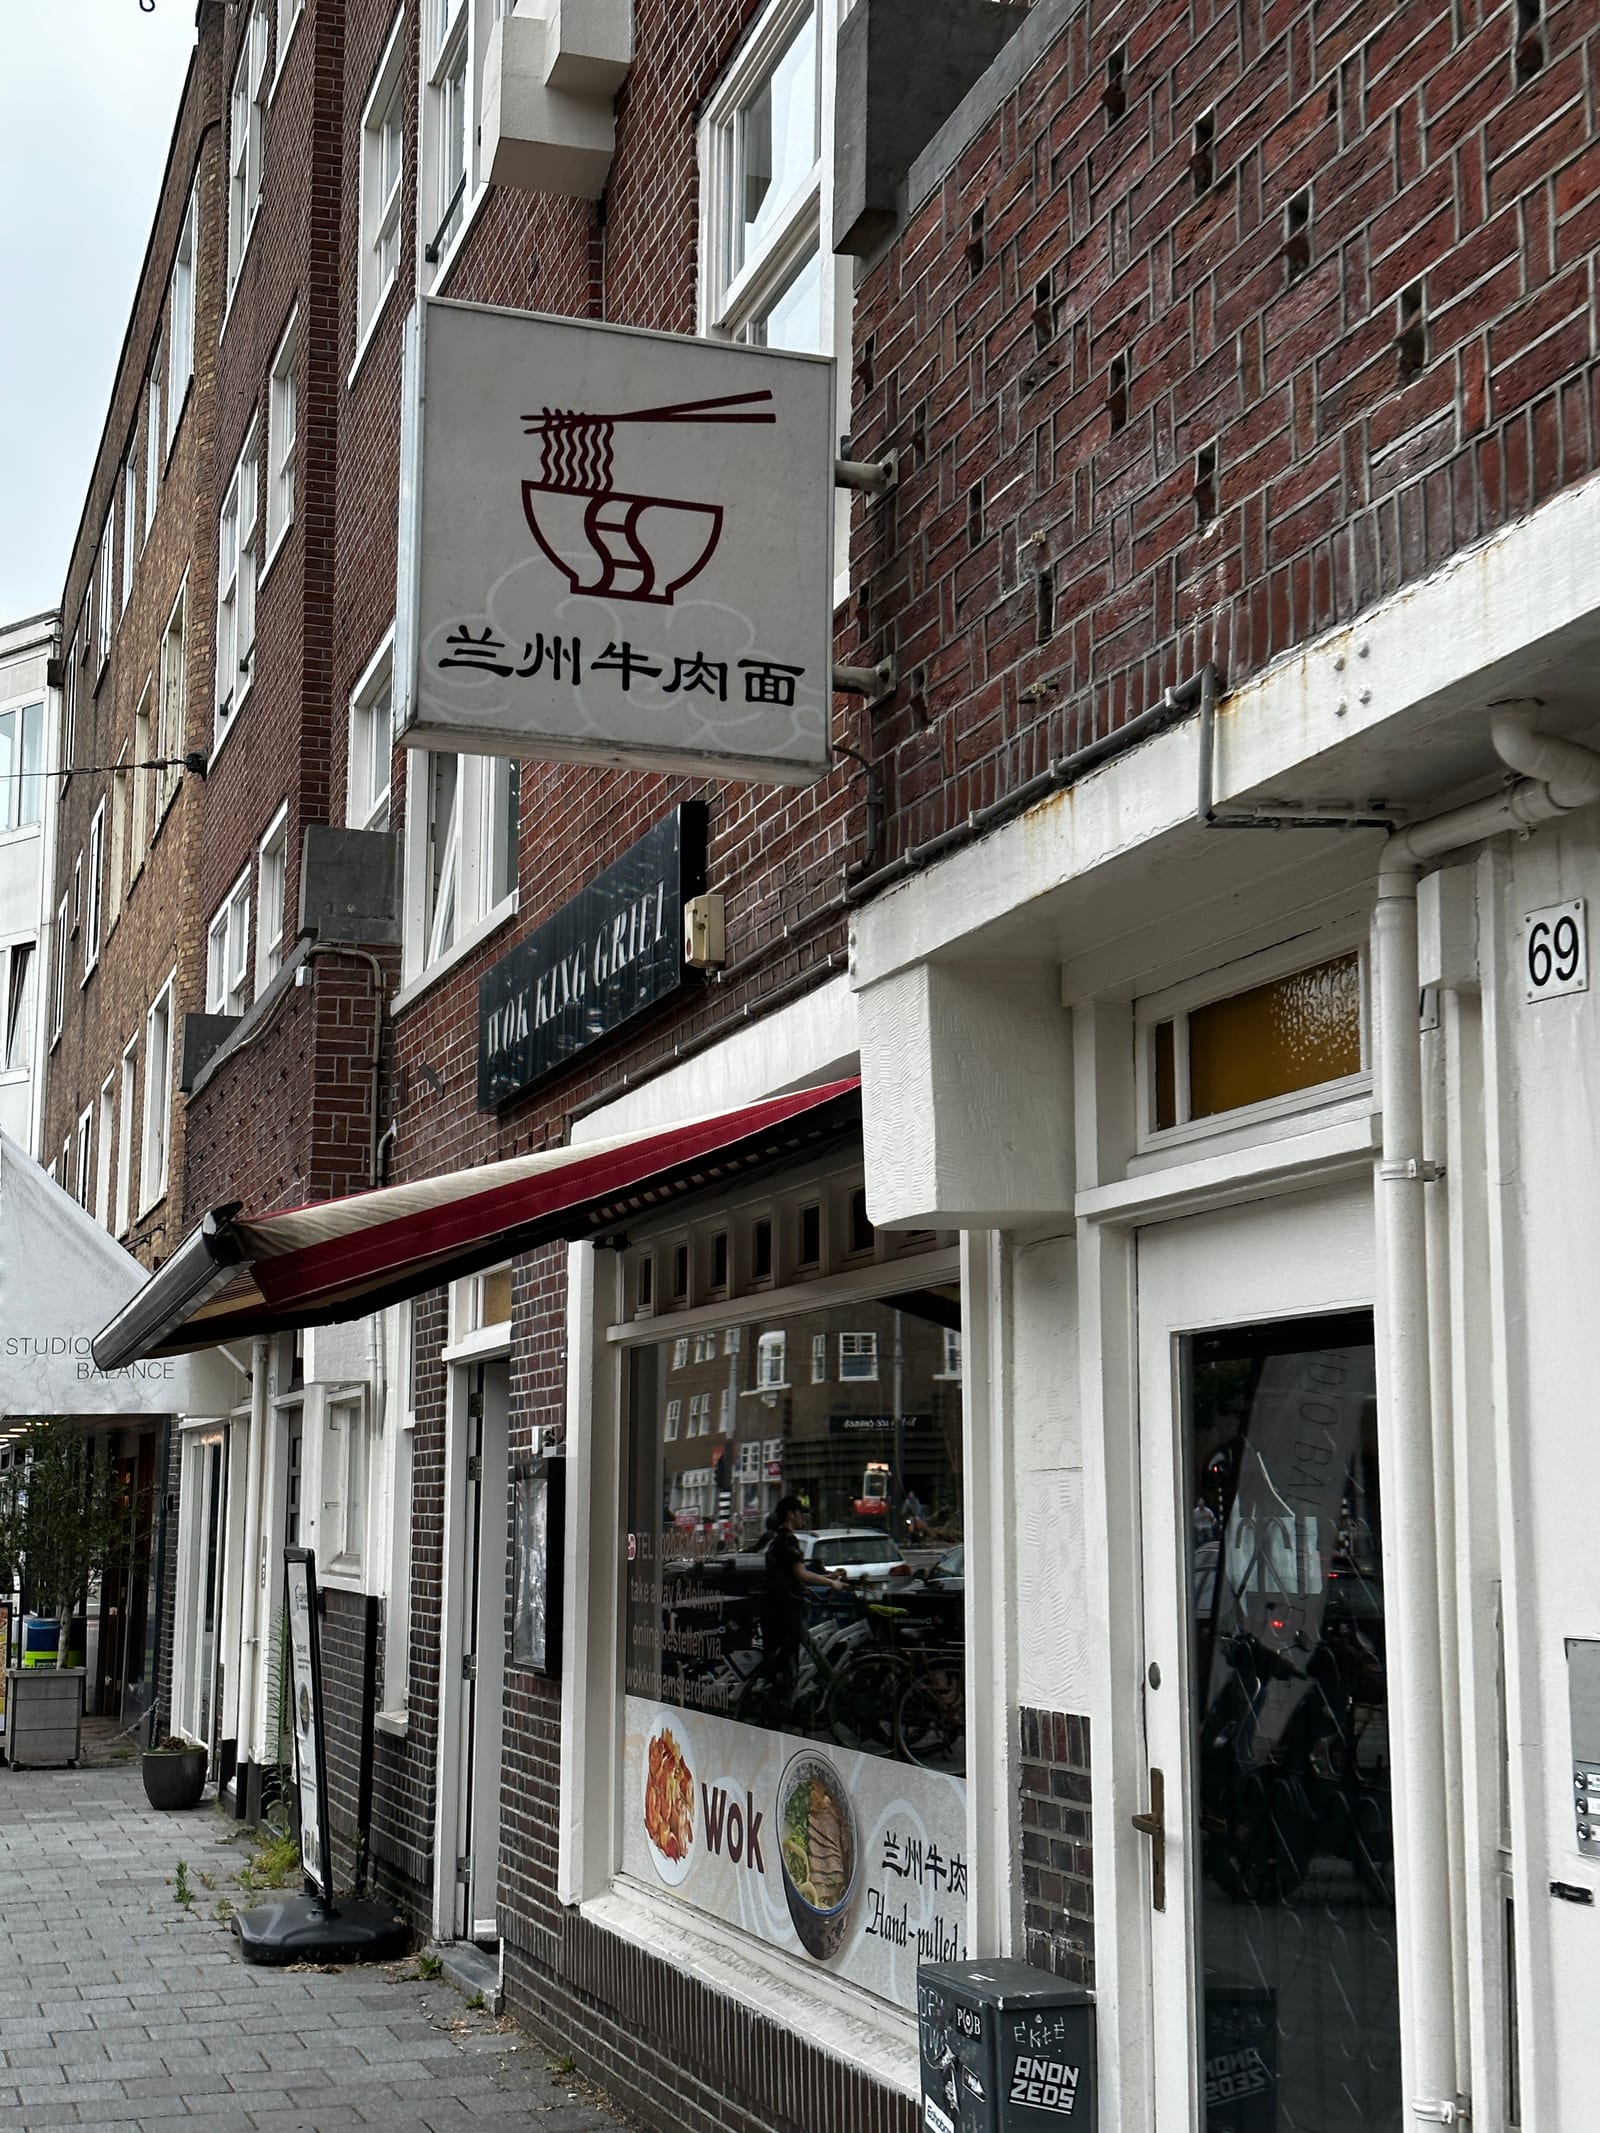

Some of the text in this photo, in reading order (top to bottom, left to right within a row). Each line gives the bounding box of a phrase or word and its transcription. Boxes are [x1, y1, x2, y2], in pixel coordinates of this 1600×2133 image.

[438, 624, 805, 707] 兰州牛肉面
[487, 880, 667, 1062] WOK KING GRILL
[1528, 915, 1579, 987] 69
[5, 1337, 92, 1356] STUDIO
[630, 1575, 649, 1603] take
[650, 1584, 674, 1611] away
[676, 1579, 683, 1605] &
[632, 1619, 722, 1660] online bestellen via
[701, 1782, 765, 1875] WOK
[881, 1830, 968, 1903] 兰州牛肉
[864, 1886, 959, 1966] Hand-pulled
[1010, 2078, 1076, 2110] ZEDS
[1014, 2055, 1080, 2088] ANON
